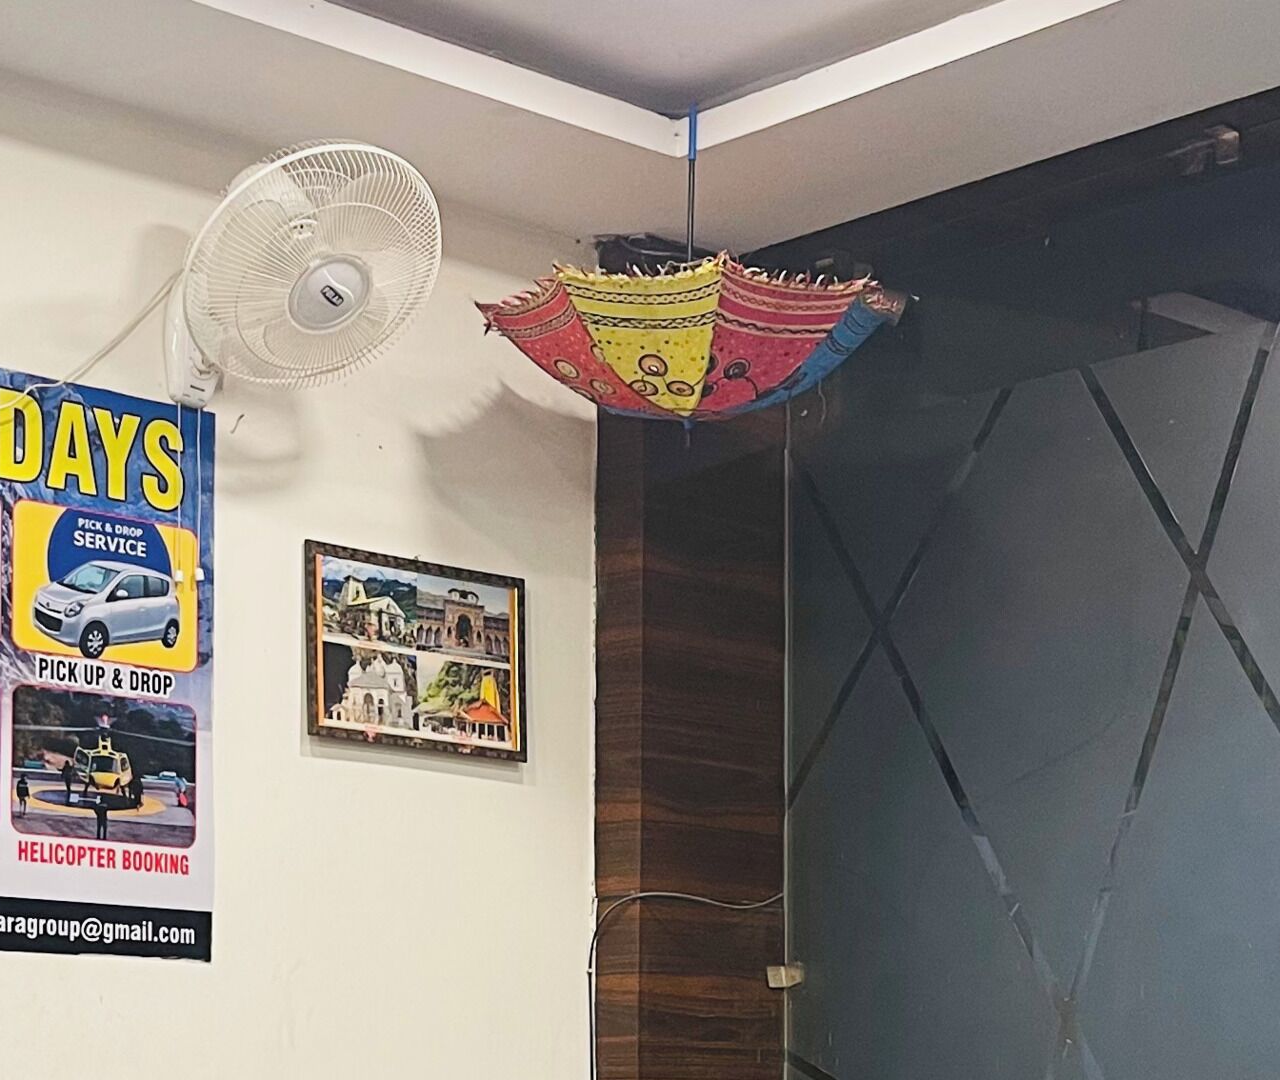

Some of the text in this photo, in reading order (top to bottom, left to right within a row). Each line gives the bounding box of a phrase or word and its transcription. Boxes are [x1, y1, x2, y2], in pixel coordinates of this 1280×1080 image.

[77, 517, 144, 537] PICK & DROP
[73, 530, 147, 558] SERVICE
[38, 658, 174, 696] PICK UP & DROP
[18, 841, 189, 875] HELICOPTER BOOKING
